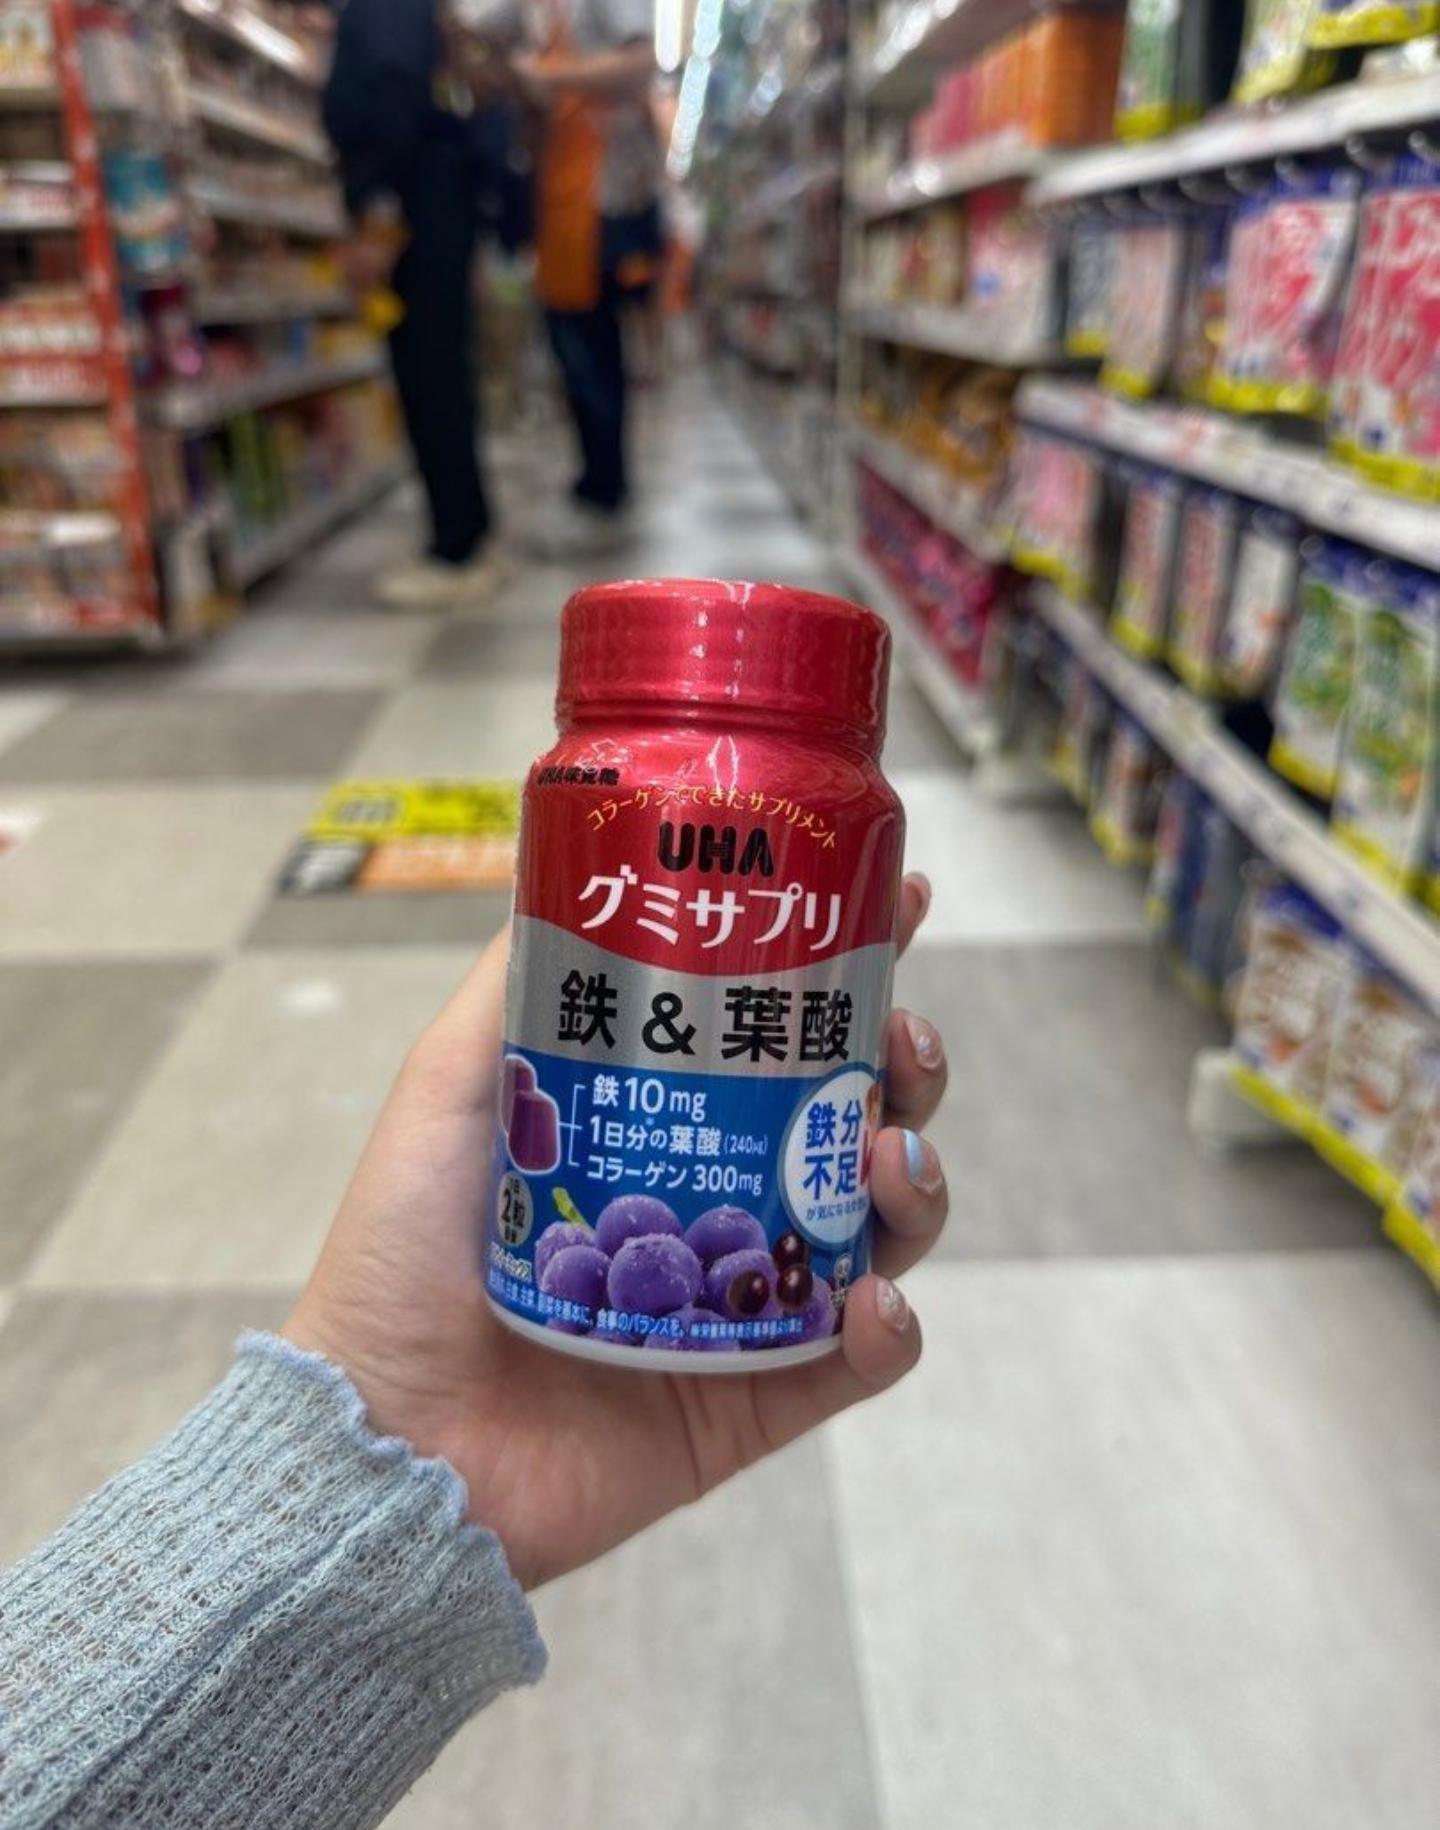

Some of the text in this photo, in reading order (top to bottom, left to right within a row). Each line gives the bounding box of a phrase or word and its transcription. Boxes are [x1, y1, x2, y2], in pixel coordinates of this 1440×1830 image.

[658, 821, 775, 878] UHA
[578, 864, 841, 951] グミサプリ
[557, 969, 854, 1062] 鉄 & 葉酸
[805, 1098, 863, 1150] 鉄分
[803, 1150, 857, 1201] 不足
